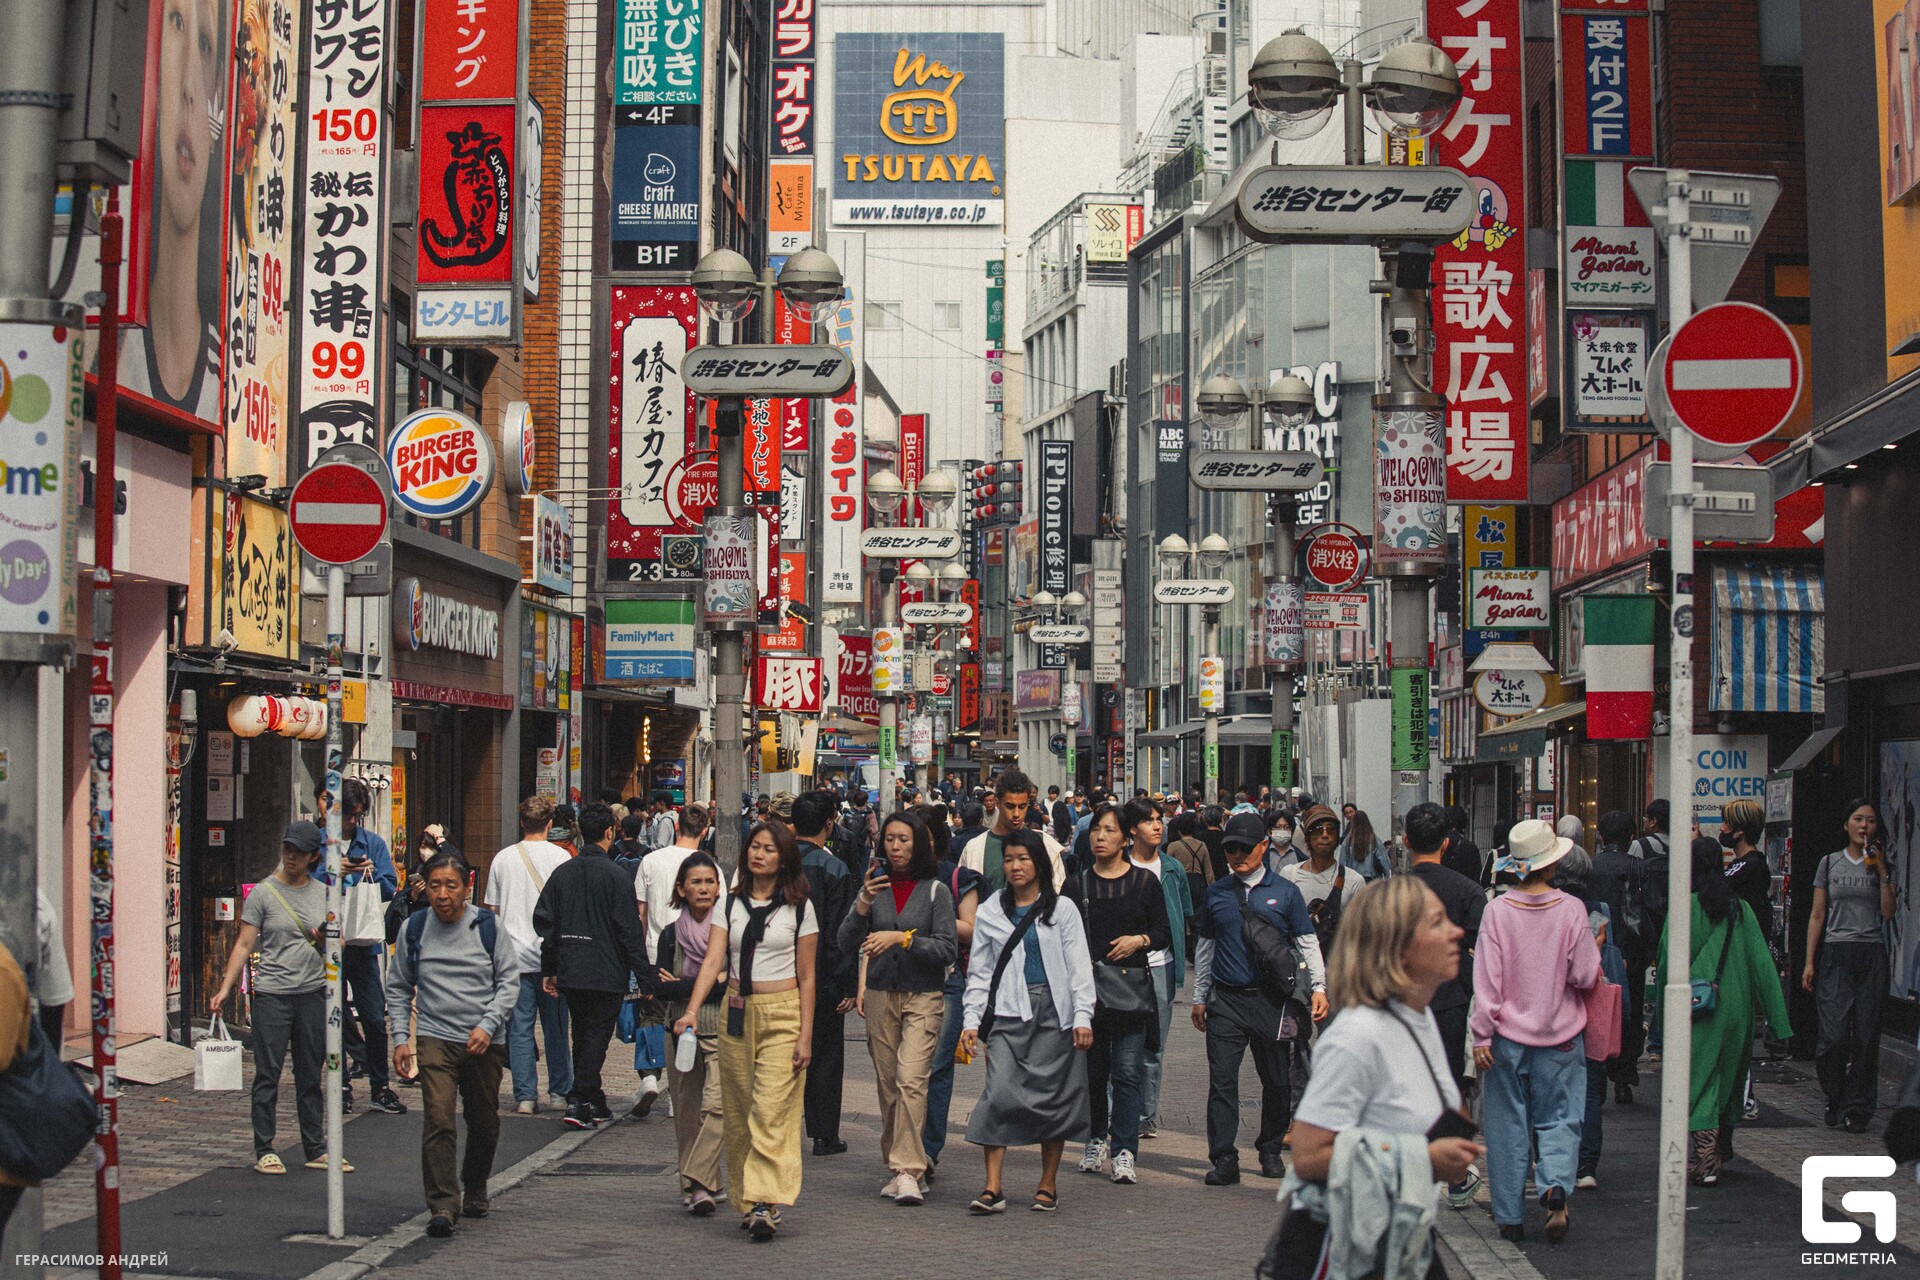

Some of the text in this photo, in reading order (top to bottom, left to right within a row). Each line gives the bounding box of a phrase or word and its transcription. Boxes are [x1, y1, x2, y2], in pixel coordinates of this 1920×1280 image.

[622, 91, 697, 102] ご相談ください
[312, 108, 377, 141] 150
[645, 106, 675, 124] 4F
[842, 154, 995, 182] TSUTAYA
[310, 171, 374, 198] 秘伝
[643, 186, 675, 202] Craft
[784, 186, 793, 209] Cafe
[794, 175, 804, 221] Miyama
[1253, 186, 1463, 213] 渋谷センター街
[618, 204, 699, 220] CHEESE MARKET
[849, 204, 986, 222] www.tsutaya.co.jp
[781, 237, 798, 248] 2F
[1570, 237, 1638, 255] Miami
[637, 245, 678, 265] B1F
[309, 202, 369, 333] かわ串
[1570, 281, 1652, 293] マイアミガーデン
[418, 300, 510, 327] センタービル
[312, 341, 366, 379] 99
[690, 358, 843, 379] 渋谷センター街
[1442, 260, 1515, 482] 歌広場
[244, 377, 270, 446] 150
[631, 341, 676, 502] 椿屋カフェ
[1159, 428, 1184, 440] ABC
[396, 430, 475, 467] BURGER
[1159, 441, 1184, 449] MART
[399, 447, 478, 494] KING
[1198, 462, 1316, 477] 渋谷センター街
[1380, 457, 1443, 487] WELCOME
[683, 484, 718, 506] 消火
[1393, 489, 1446, 503] SHIBUYA
[865, 536, 954, 548] 渋谷センター街
[1329, 539, 1351, 547] HYDRANT
[1312, 549, 1355, 570] 消火栓
[1160, 586, 1229, 596] 渋谷センター街
[1475, 585, 1533, 601] Miami
[423, 593, 471, 654] BURGER
[472, 604, 498, 660] KING
[1266, 608, 1302, 625] WELCOME
[611, 630, 674, 645] FamilyMart
[1480, 631, 1500, 640] 24h
[620, 661, 664, 675] 酒 たばこ
[841, 650, 873, 676] カラ
[763, 658, 816, 708] 豚
[840, 694, 861, 715] BIG
[1409, 674, 1424, 764] 客引きは犯罪です
[1697, 750, 1747, 769] COIN
